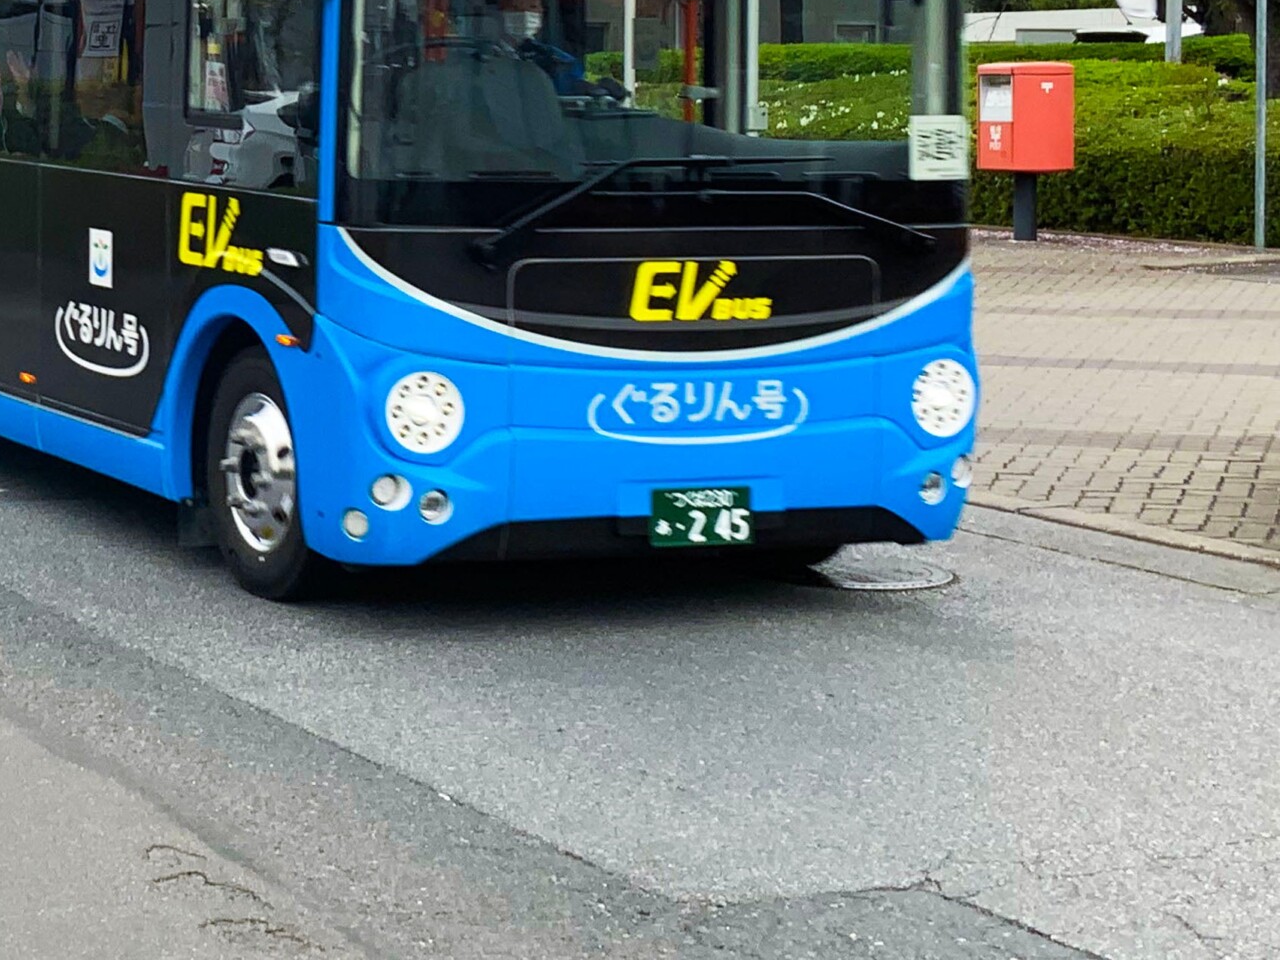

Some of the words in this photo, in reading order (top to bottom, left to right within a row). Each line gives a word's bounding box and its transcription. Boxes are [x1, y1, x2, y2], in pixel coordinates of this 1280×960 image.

[179, 191, 241, 269] EV
[629, 259, 738, 322] EV
[710, 297, 773, 321] BUS
[64, 300, 141, 357] ぐるりん号
[611, 379, 788, 425] ぐるりん号
